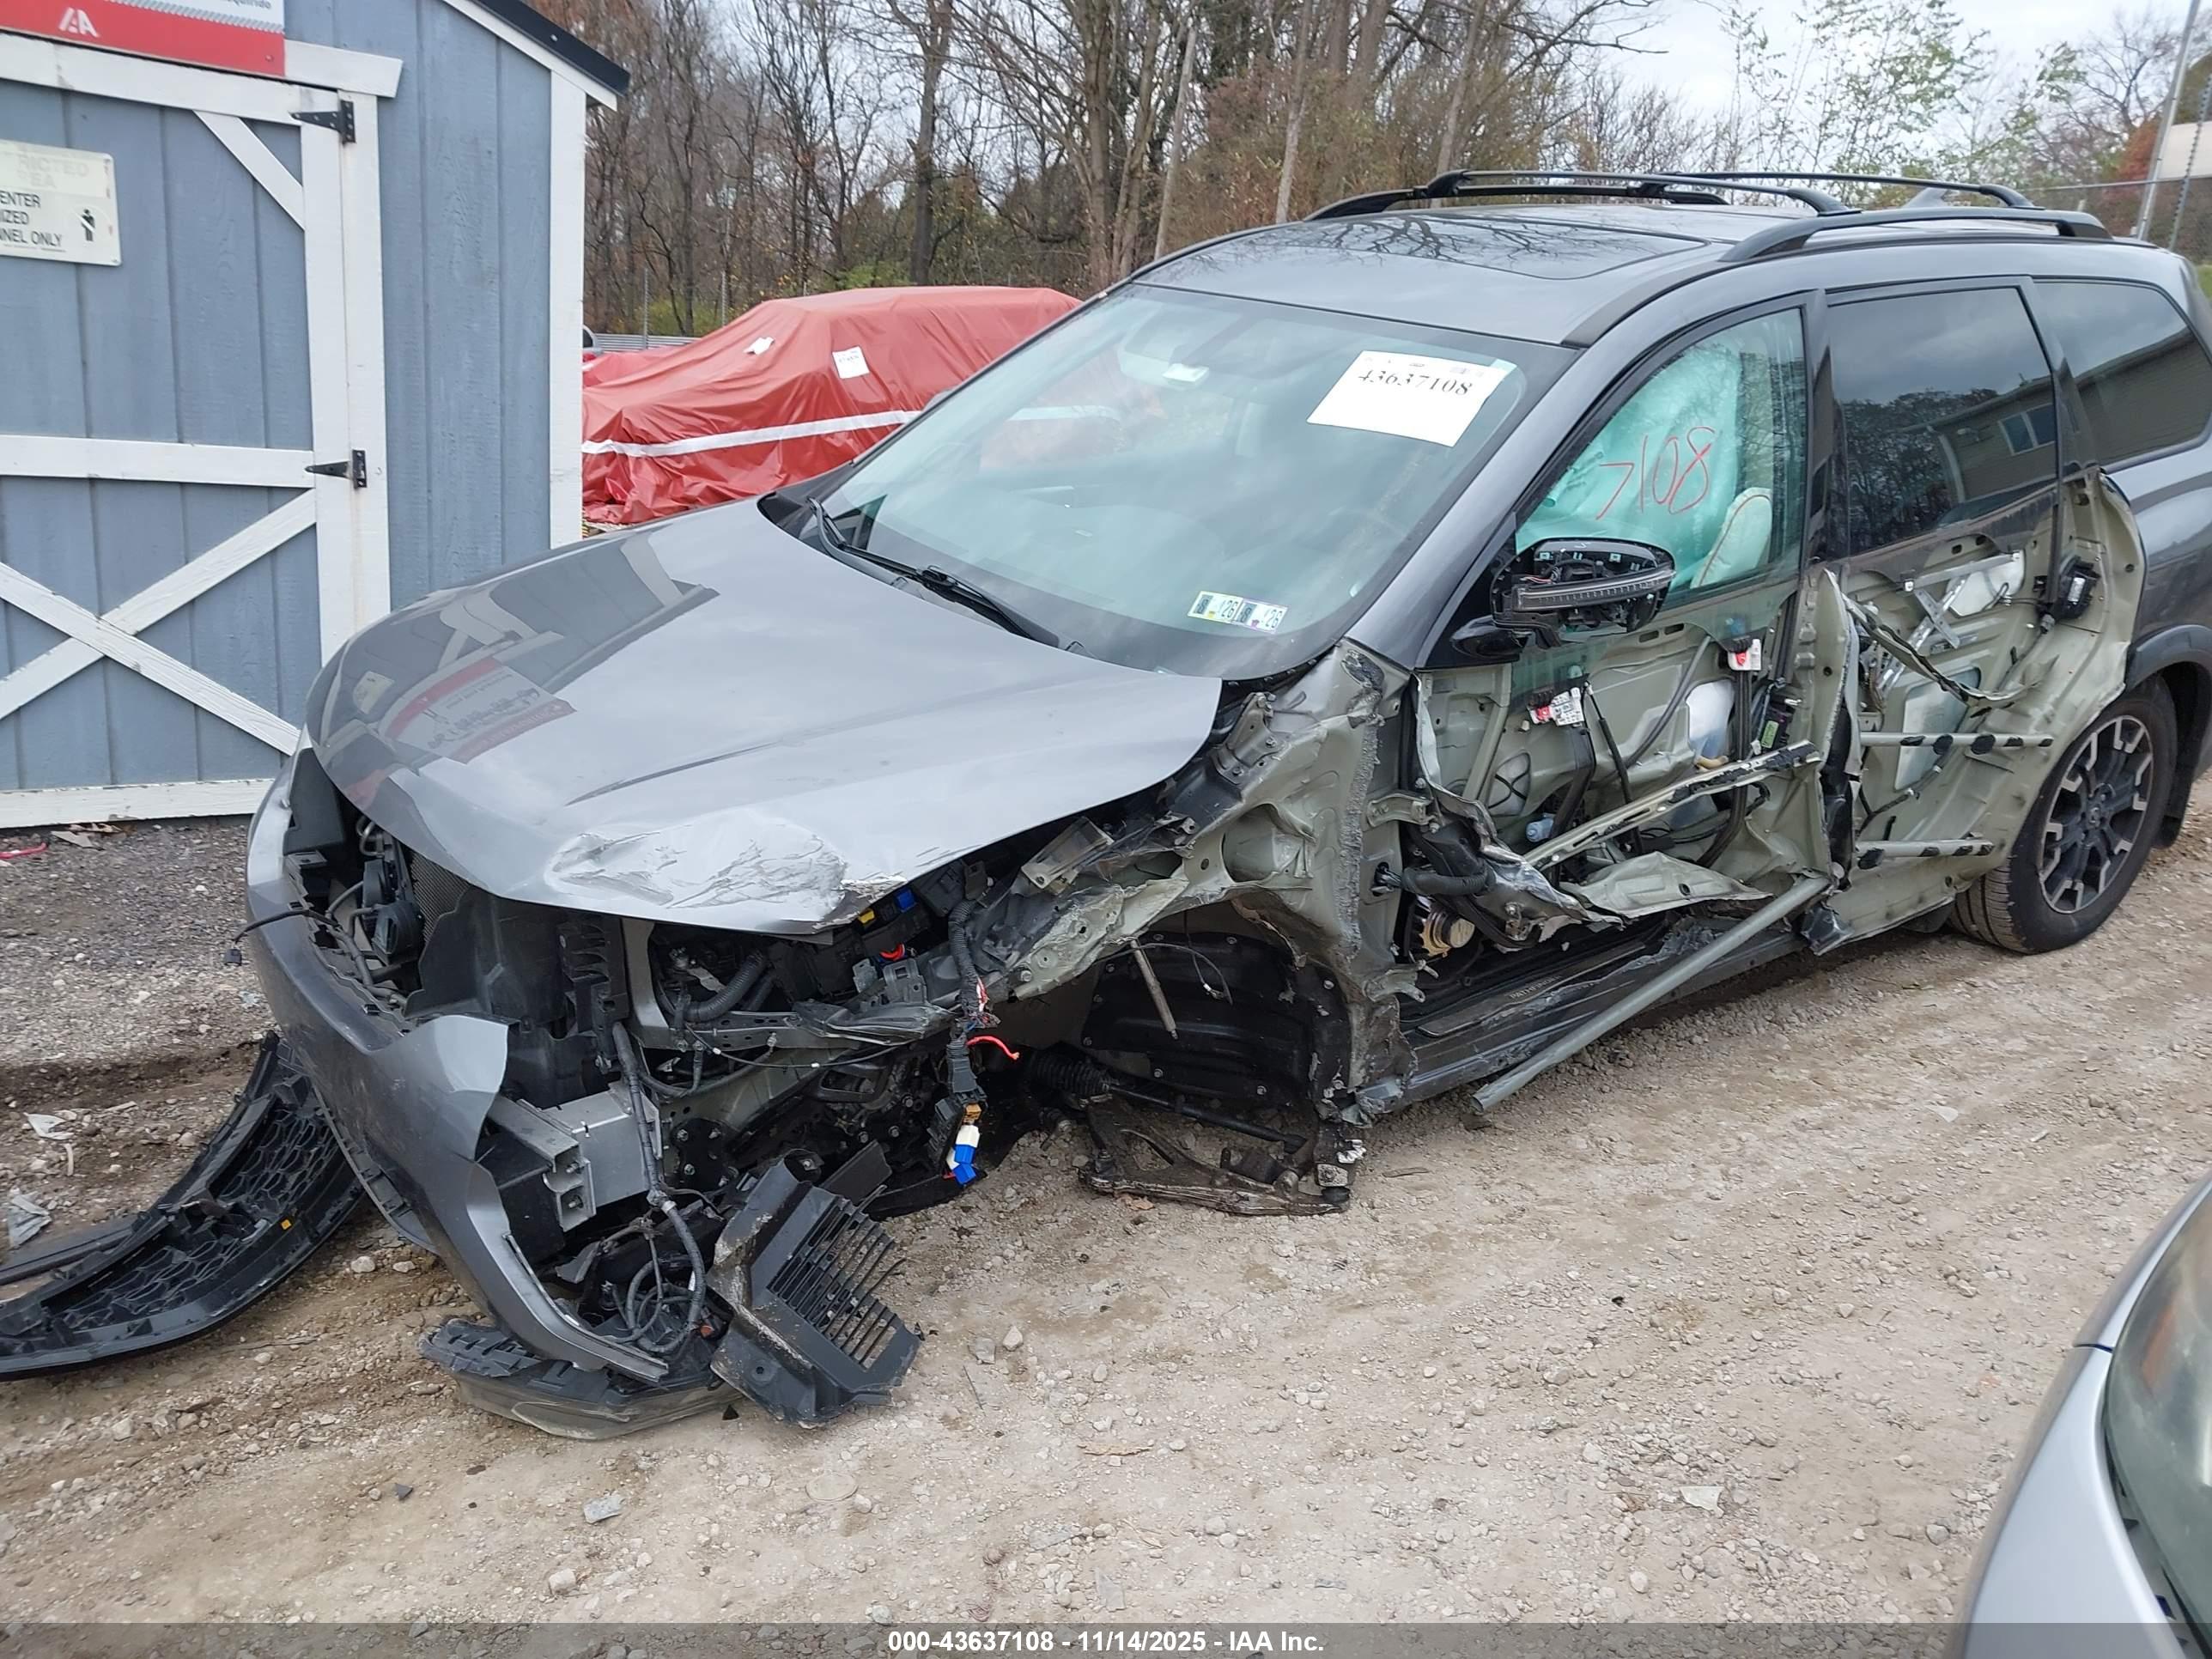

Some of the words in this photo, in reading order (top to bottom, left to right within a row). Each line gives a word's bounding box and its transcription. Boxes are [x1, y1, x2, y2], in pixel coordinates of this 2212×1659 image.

[31, 231, 62, 247] ONLY
[1358, 368, 1473, 397] 43637108
[1595, 426, 1716, 520] 7108
